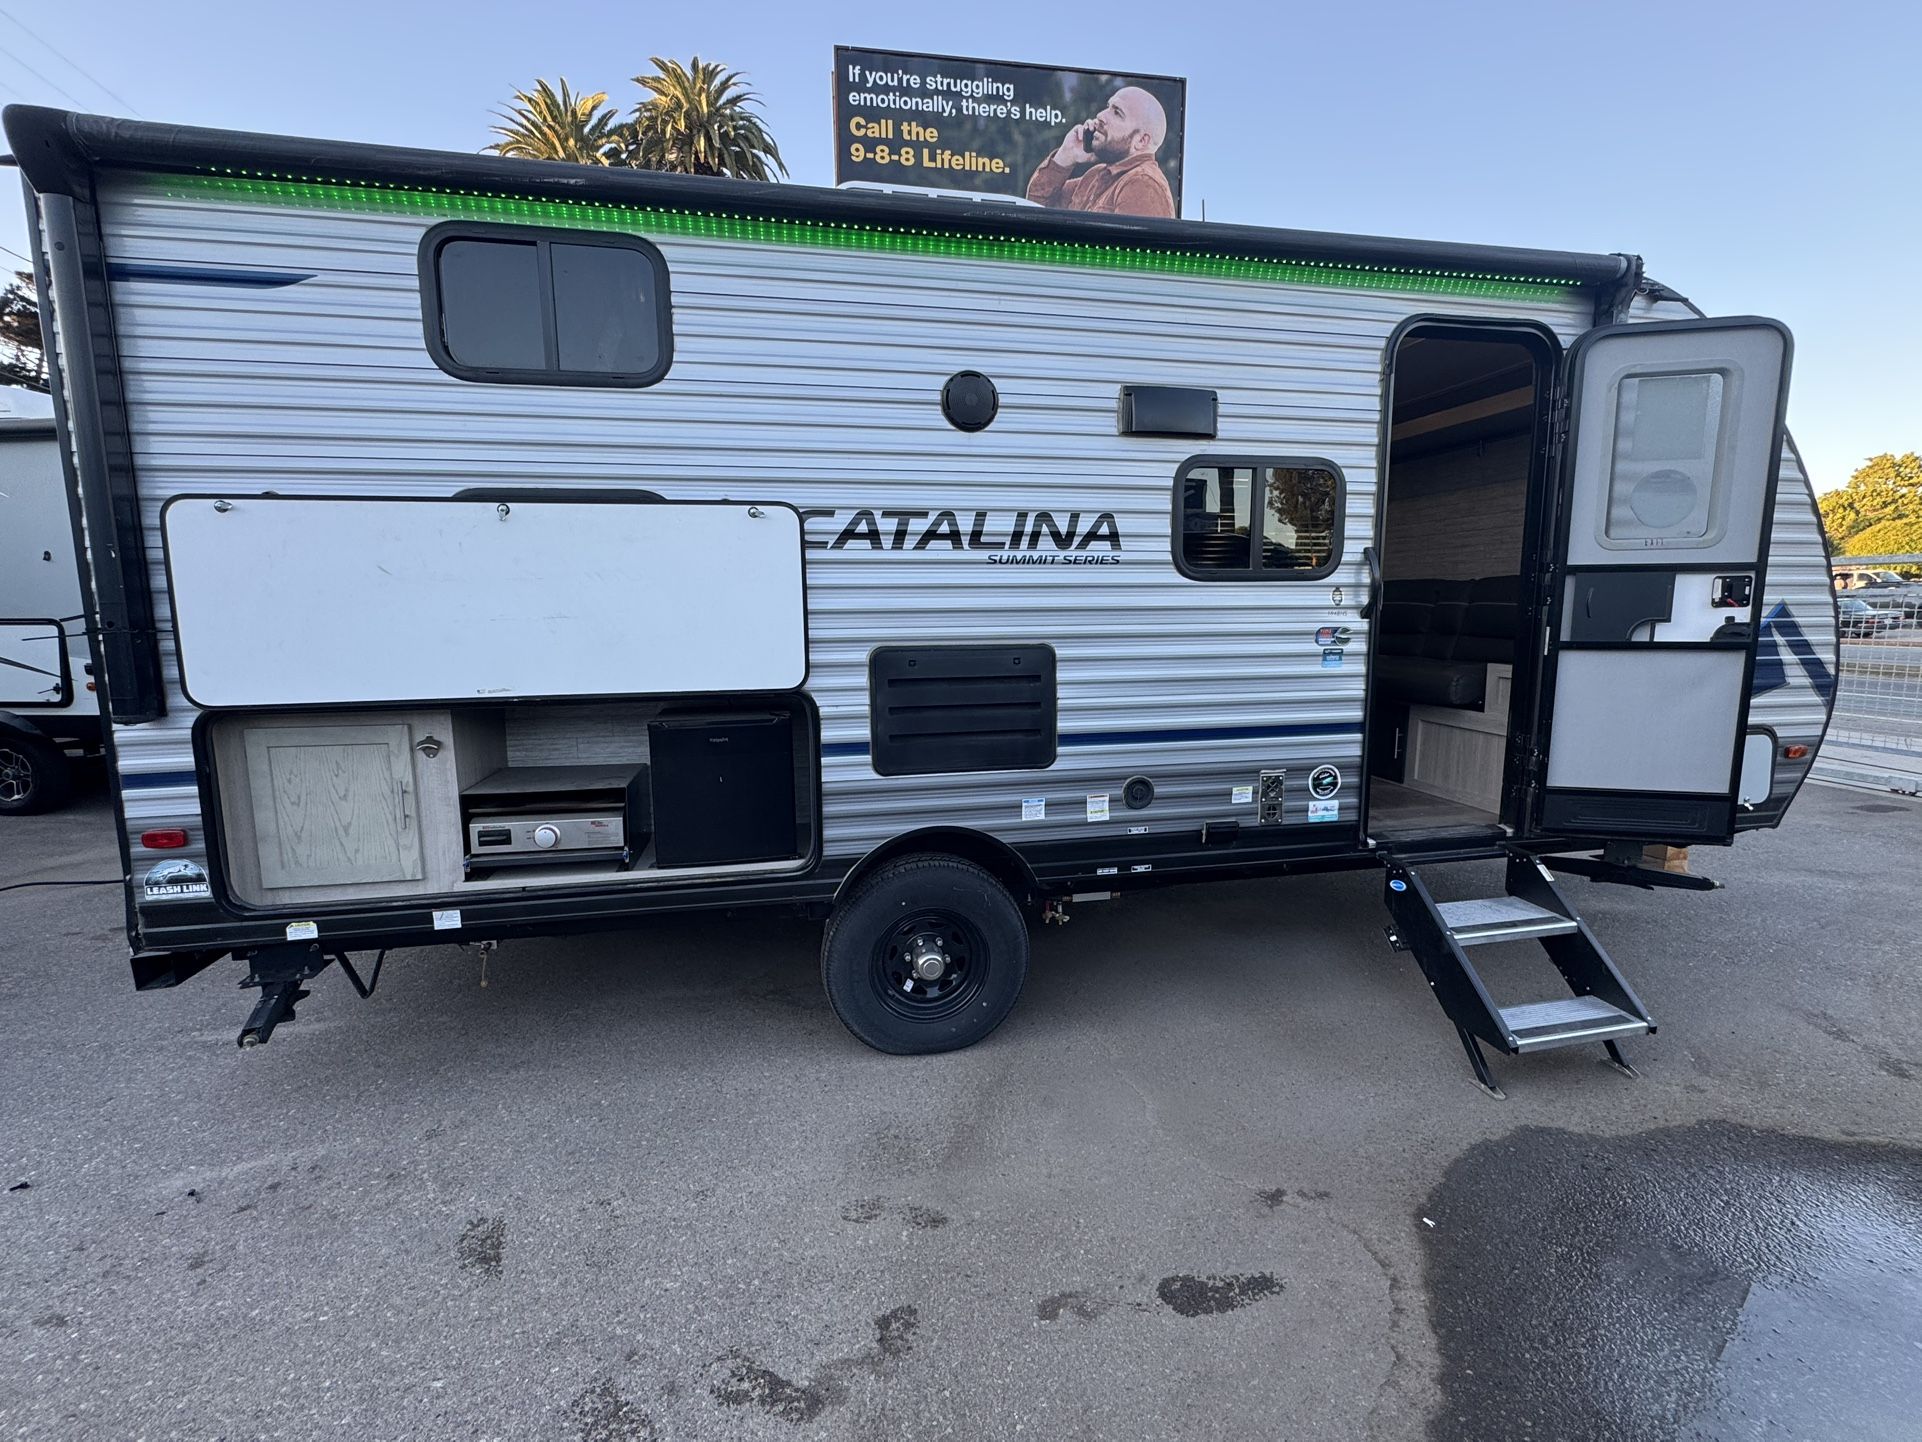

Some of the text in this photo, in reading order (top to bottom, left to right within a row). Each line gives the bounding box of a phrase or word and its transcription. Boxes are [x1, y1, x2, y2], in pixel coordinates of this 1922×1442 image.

[848, 65, 1014, 100] If you're struggling
[848, 91, 1066, 126] emotionally, there's help.
[849, 116, 938, 143] Call the
[850, 143, 1010, 173] 9-8-8 Lifeline.
[800, 509, 1123, 550] CATALINA
[986, 554, 1121, 565] SUMMIT SERIES
[147, 884, 208, 895] LEASH LINK
